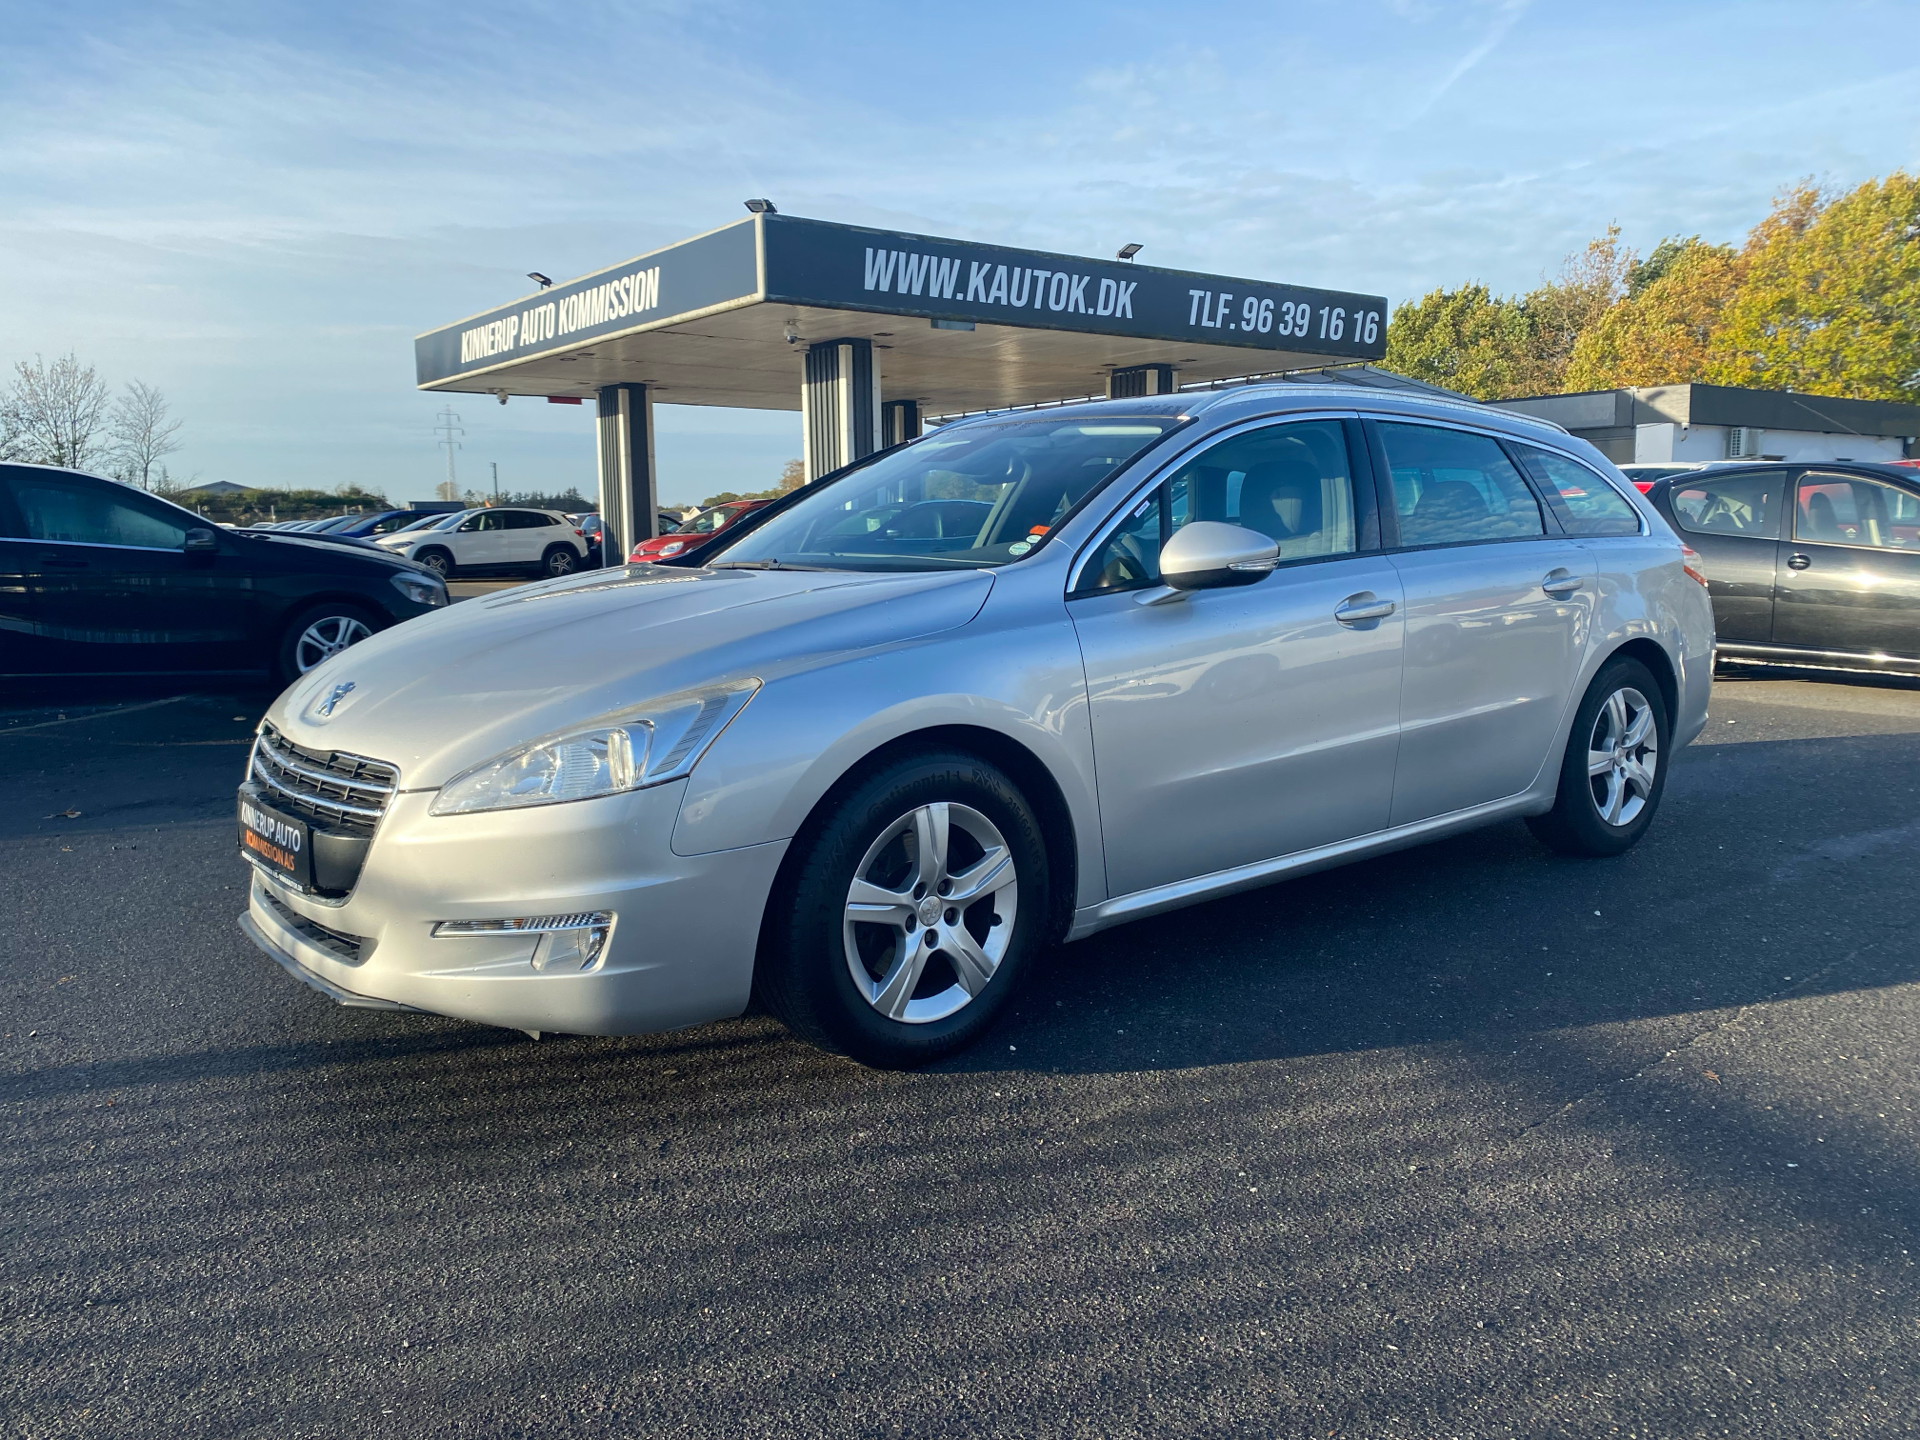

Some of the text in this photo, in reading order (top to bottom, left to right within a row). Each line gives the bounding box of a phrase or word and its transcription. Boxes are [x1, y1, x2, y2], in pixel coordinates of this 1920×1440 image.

[864, 247, 1138, 319] WWW.KAUTOK.DK
[461, 267, 660, 364] KINNERUP AUTO KOMMISSION
[1188, 289, 1380, 345] TLF. 96 39 16 16
[241, 801, 300, 852] KINNERUP AUTO
